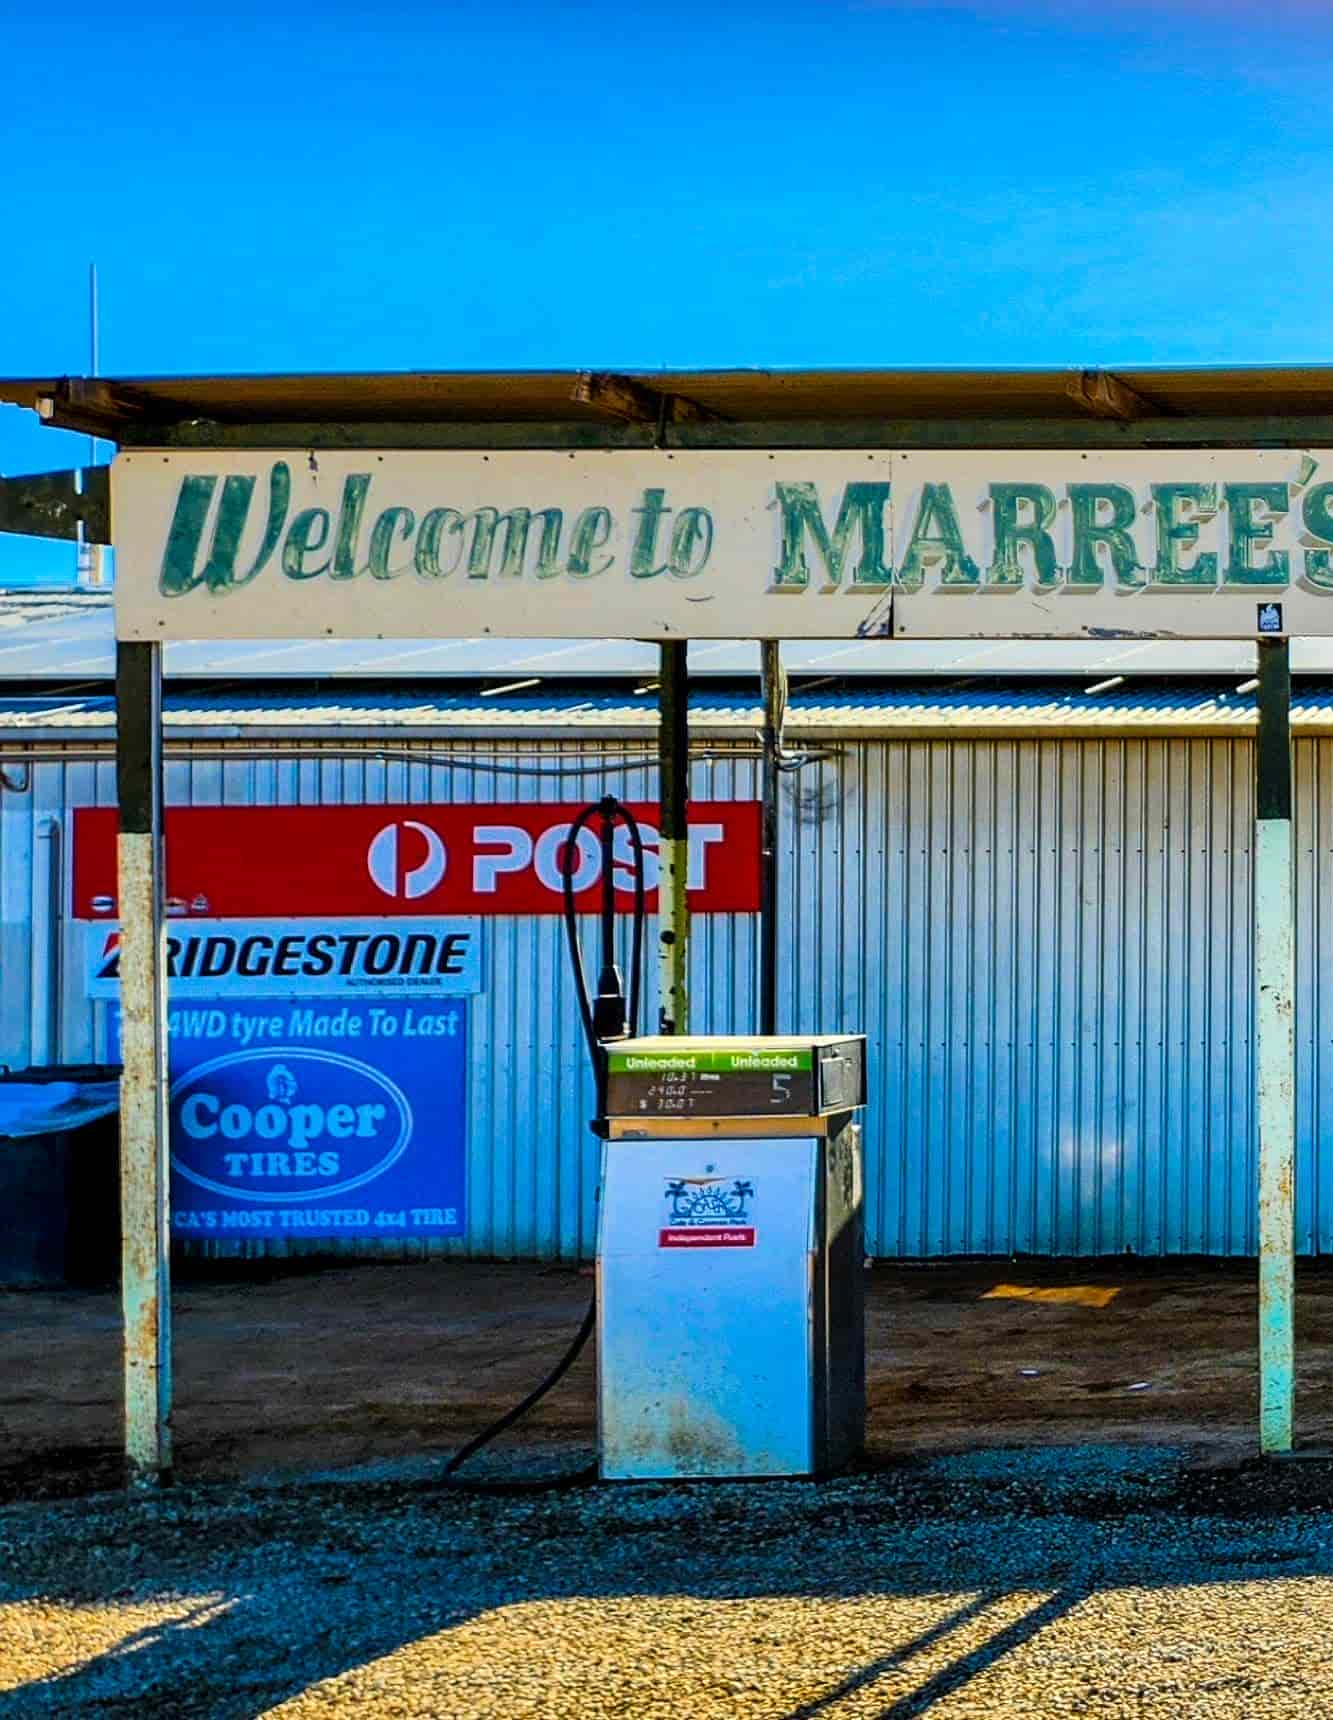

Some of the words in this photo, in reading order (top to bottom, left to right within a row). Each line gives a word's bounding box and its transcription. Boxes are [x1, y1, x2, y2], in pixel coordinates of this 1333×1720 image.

[158, 460, 612, 598] Welcome
[630, 487, 714, 580] to
[473, 823, 723, 893] POST
[168, 1009, 226, 1038] 4WD
[231, 1011, 283, 1046] tyre
[288, 1009, 362, 1038] Made
[369, 1009, 398, 1038] To
[402, 1008, 458, 1037] Last
[626, 1056, 696, 1069] Unleaded
[731, 1055, 798, 1068] Unleaded
[180, 1093, 386, 1148] Cooper
[224, 1152, 340, 1176] TIRES
[221, 1209, 274, 1228] MOST
[279, 1209, 369, 1227] TRUSTED
[373, 1209, 406, 1227] 4x4
[410, 1207, 457, 1225] TIRE
